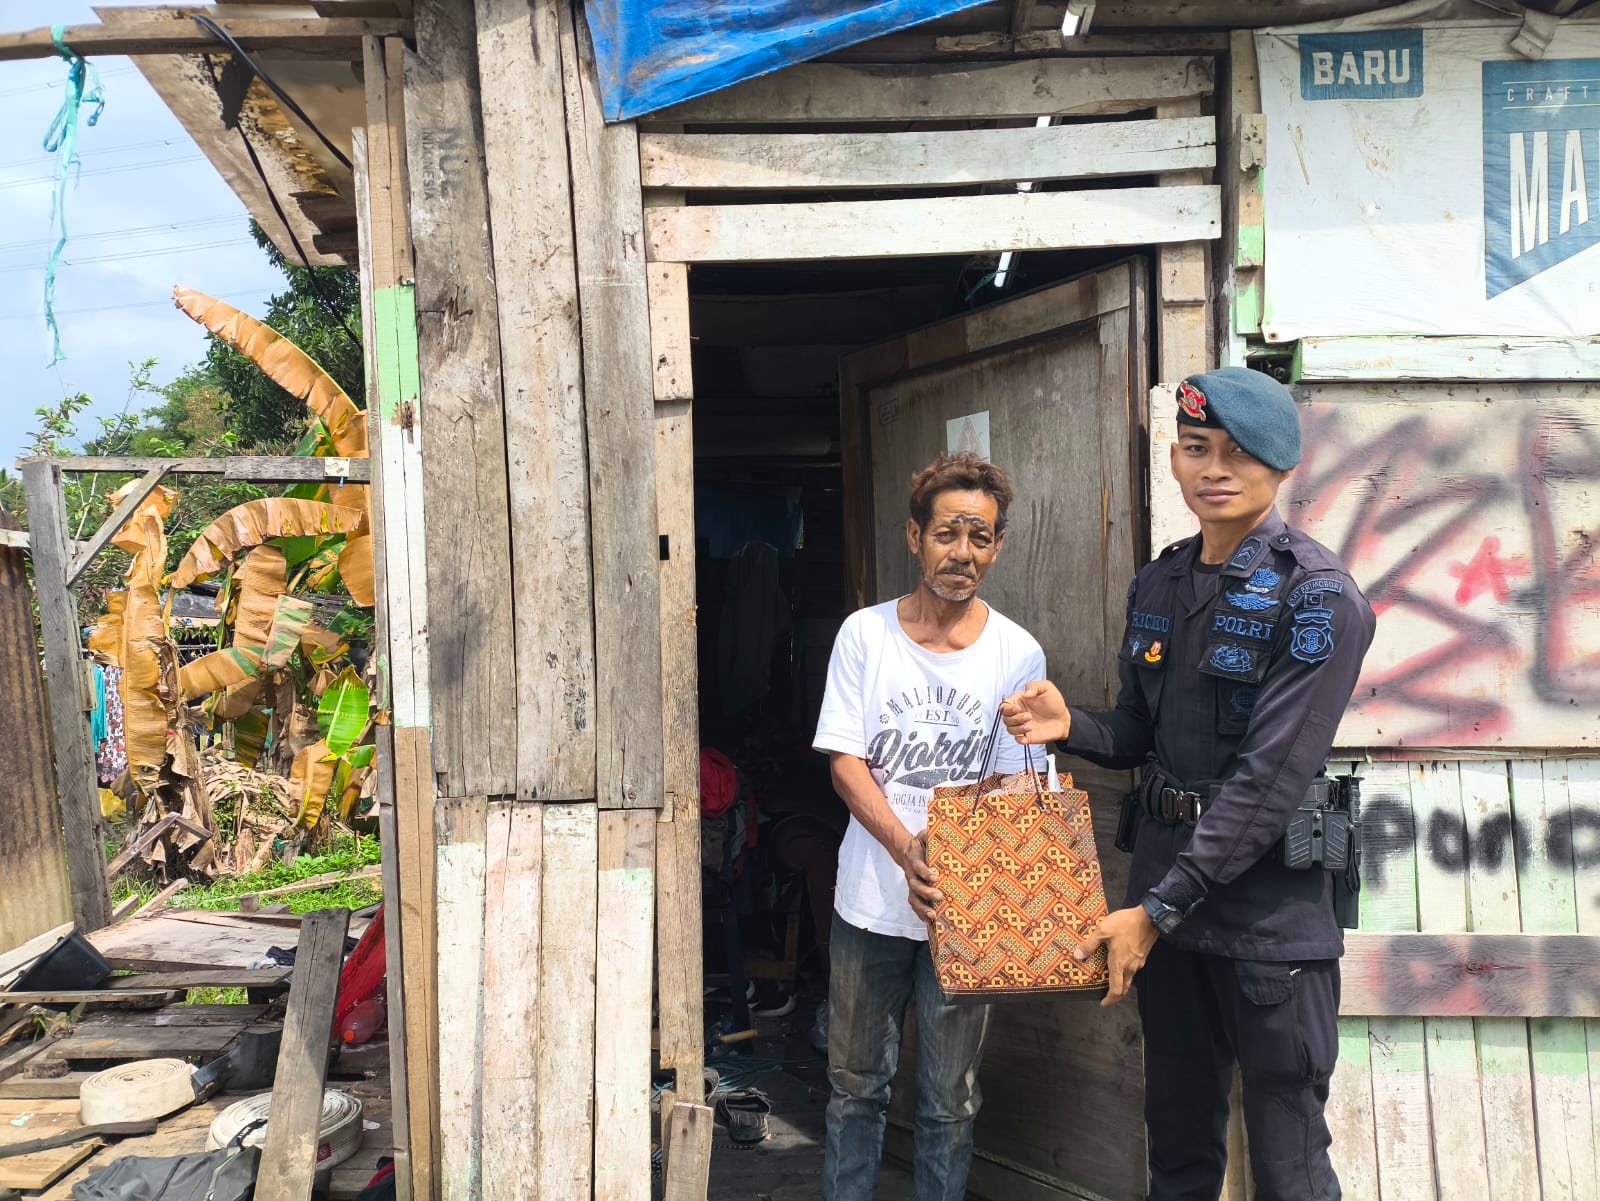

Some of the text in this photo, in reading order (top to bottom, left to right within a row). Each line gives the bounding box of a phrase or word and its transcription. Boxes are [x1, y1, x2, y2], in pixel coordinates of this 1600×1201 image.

[1312, 48, 1411, 86] BARU
[1507, 86, 1589, 102] CRAFT
[1509, 129, 1600, 260] MA
[1211, 615, 1274, 640] POLRI
